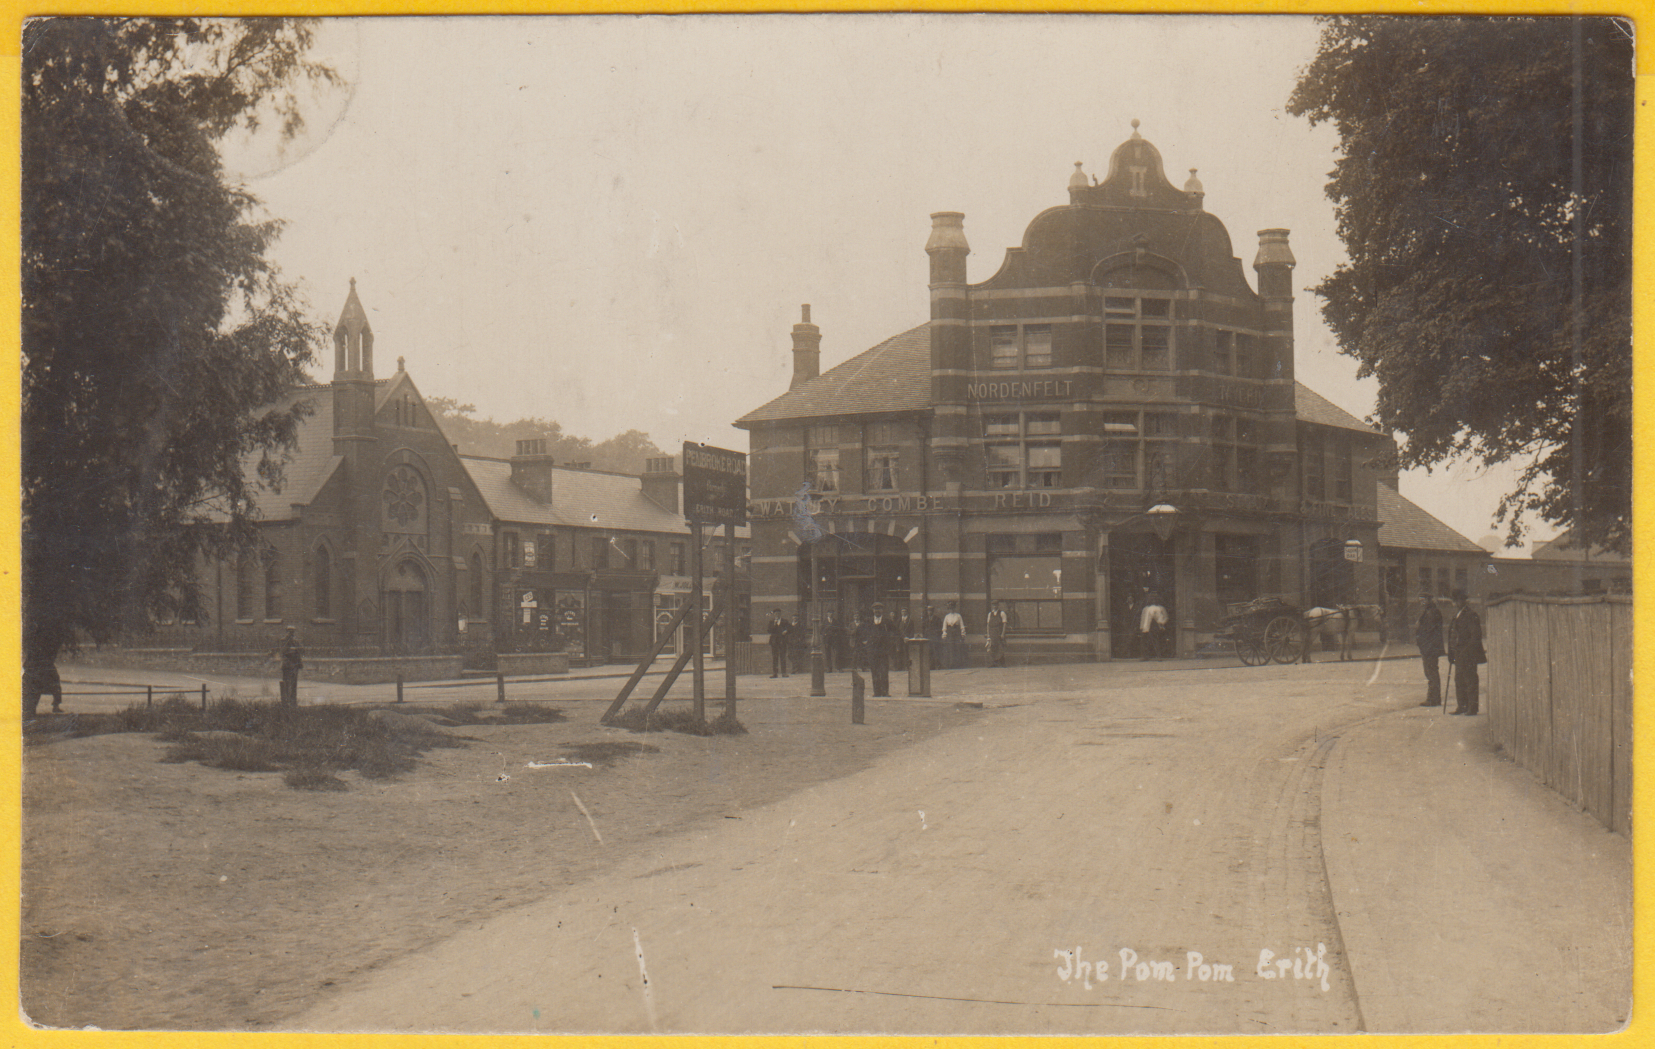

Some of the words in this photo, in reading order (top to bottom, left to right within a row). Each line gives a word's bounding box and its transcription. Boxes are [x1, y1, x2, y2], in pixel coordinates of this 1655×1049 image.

[967, 380, 1073, 398] NORDENFELT
[726, 457, 746, 475] ROAD
[760, 498, 839, 516] WATY
[867, 495, 944, 512] COMBE
[995, 492, 1051, 508] REID
